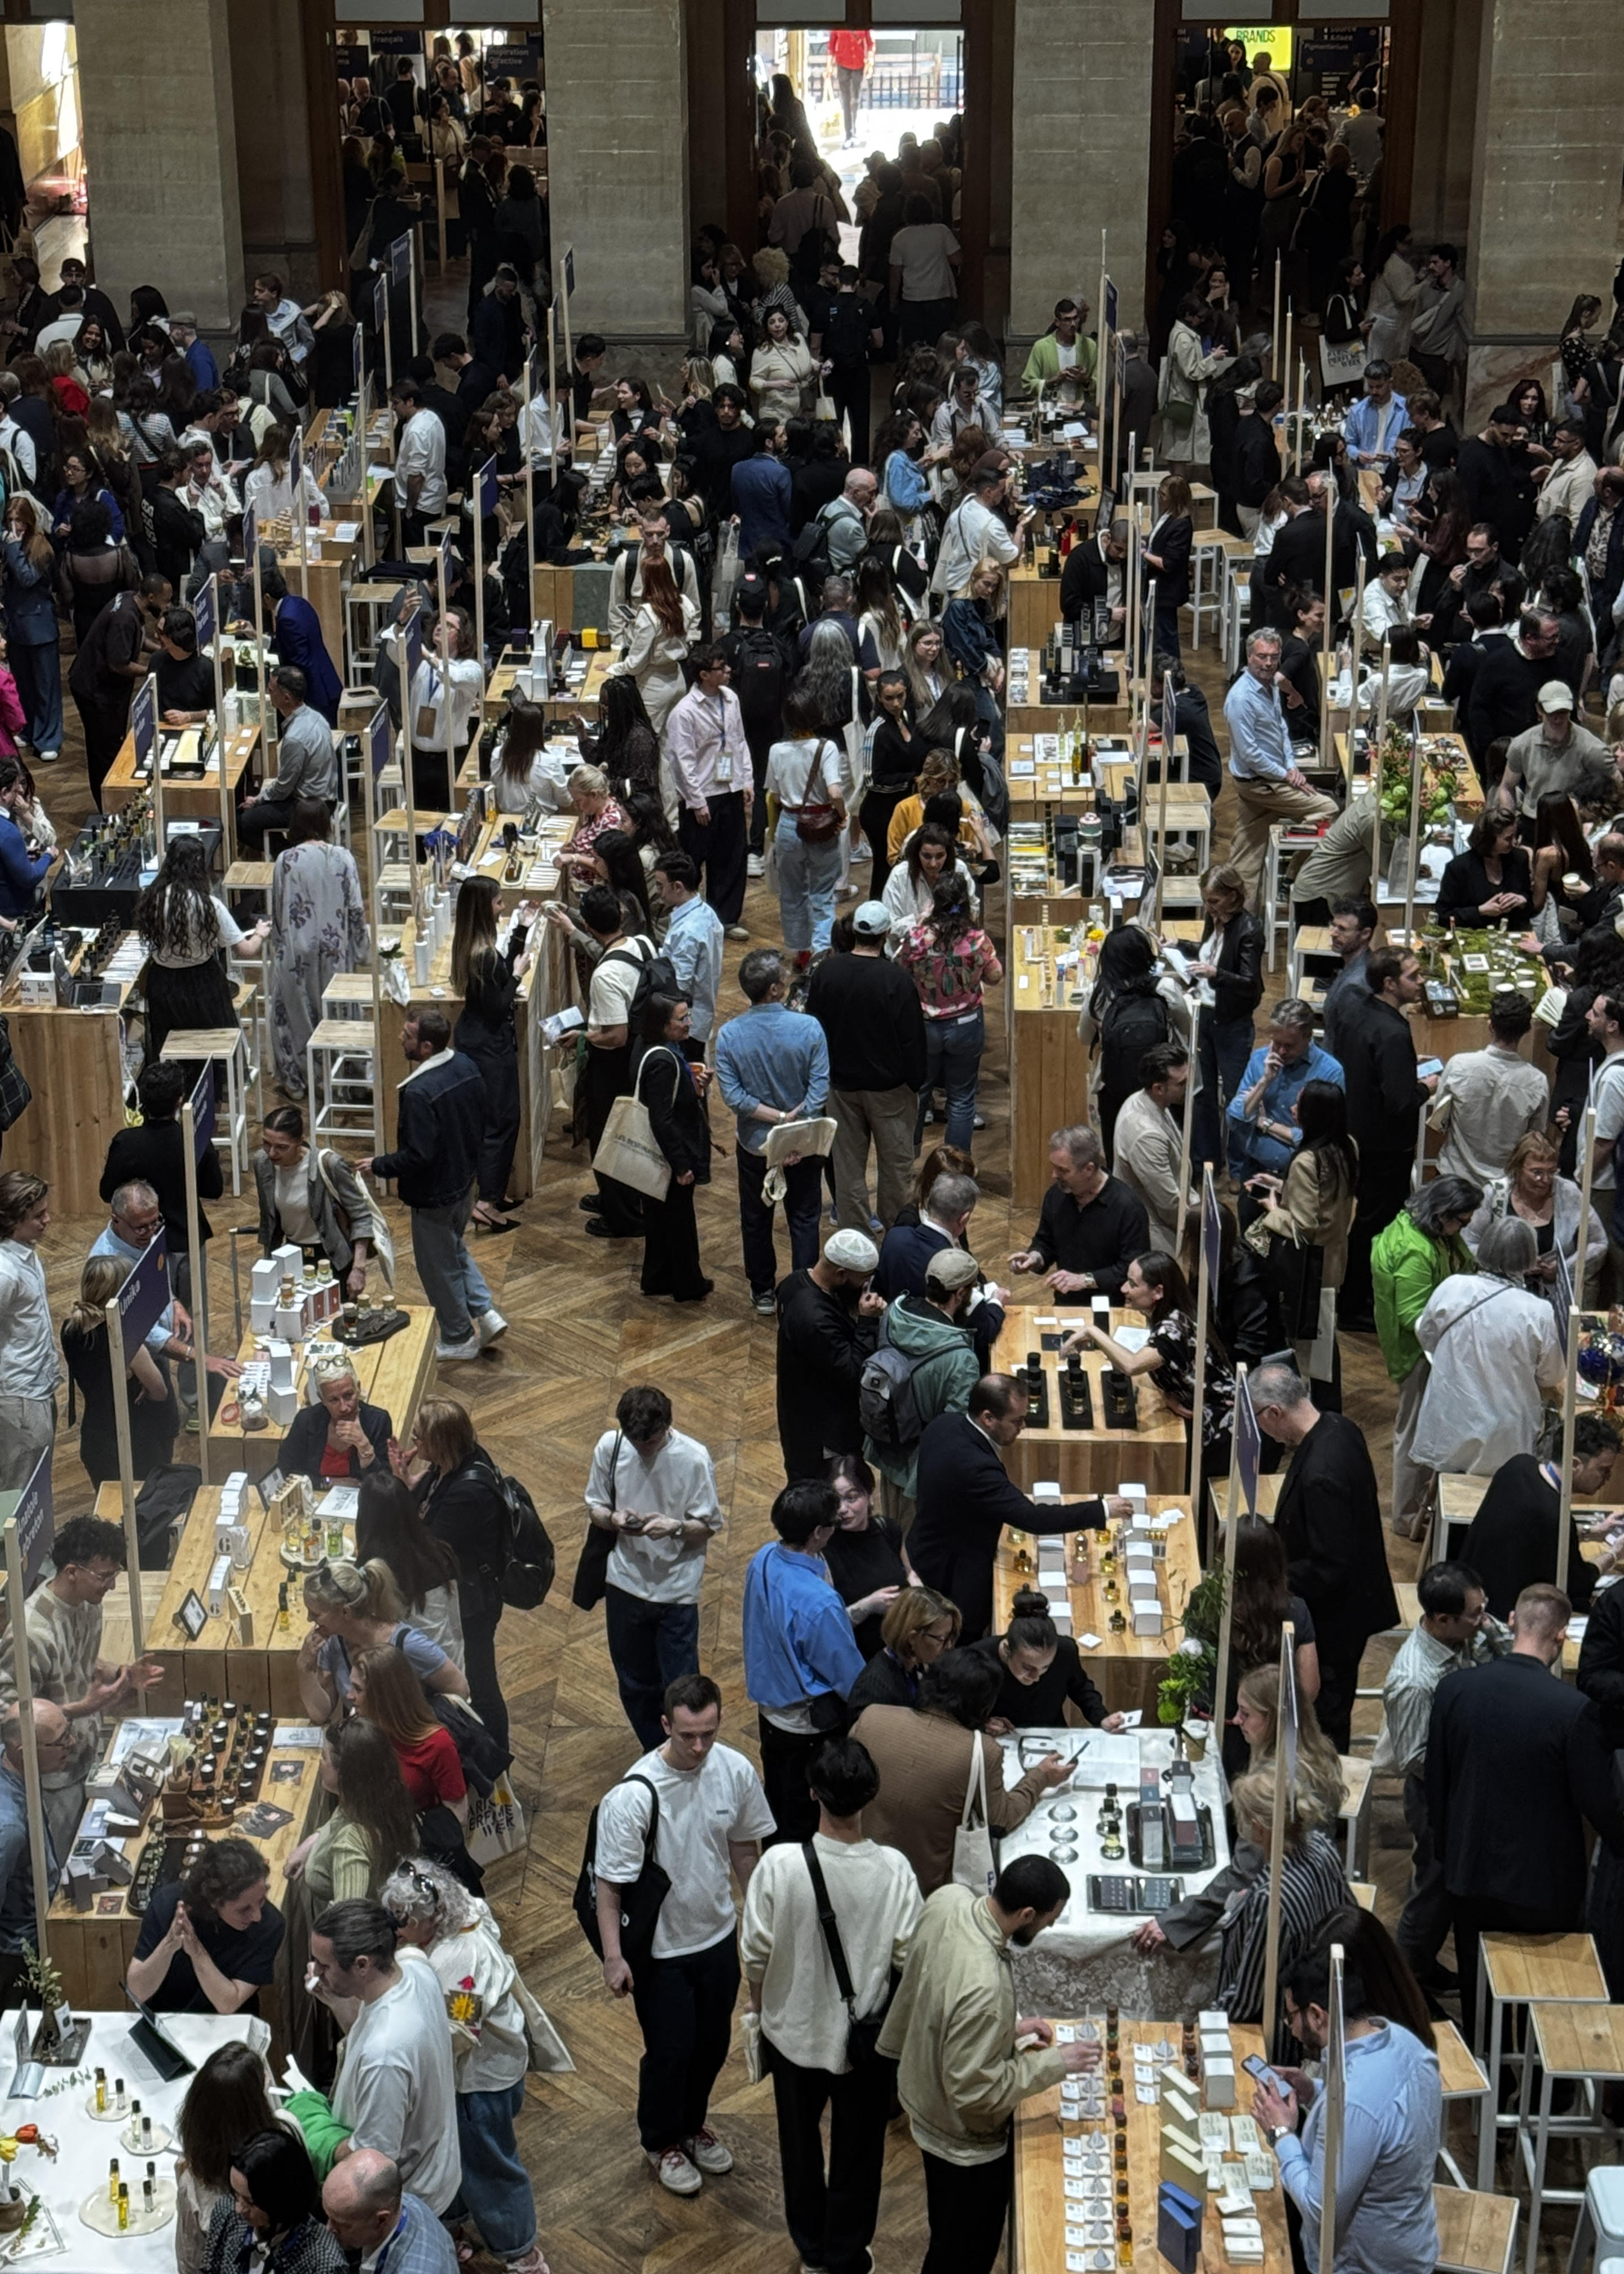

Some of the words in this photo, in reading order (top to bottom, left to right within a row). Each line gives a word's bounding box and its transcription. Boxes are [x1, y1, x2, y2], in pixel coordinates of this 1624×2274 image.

[372, 36, 404, 45] Français
[1236, 30, 1276, 42] BRANDS
[489, 47, 529, 56] Inspiration
[23, 1508, 44, 1555] ebreton
